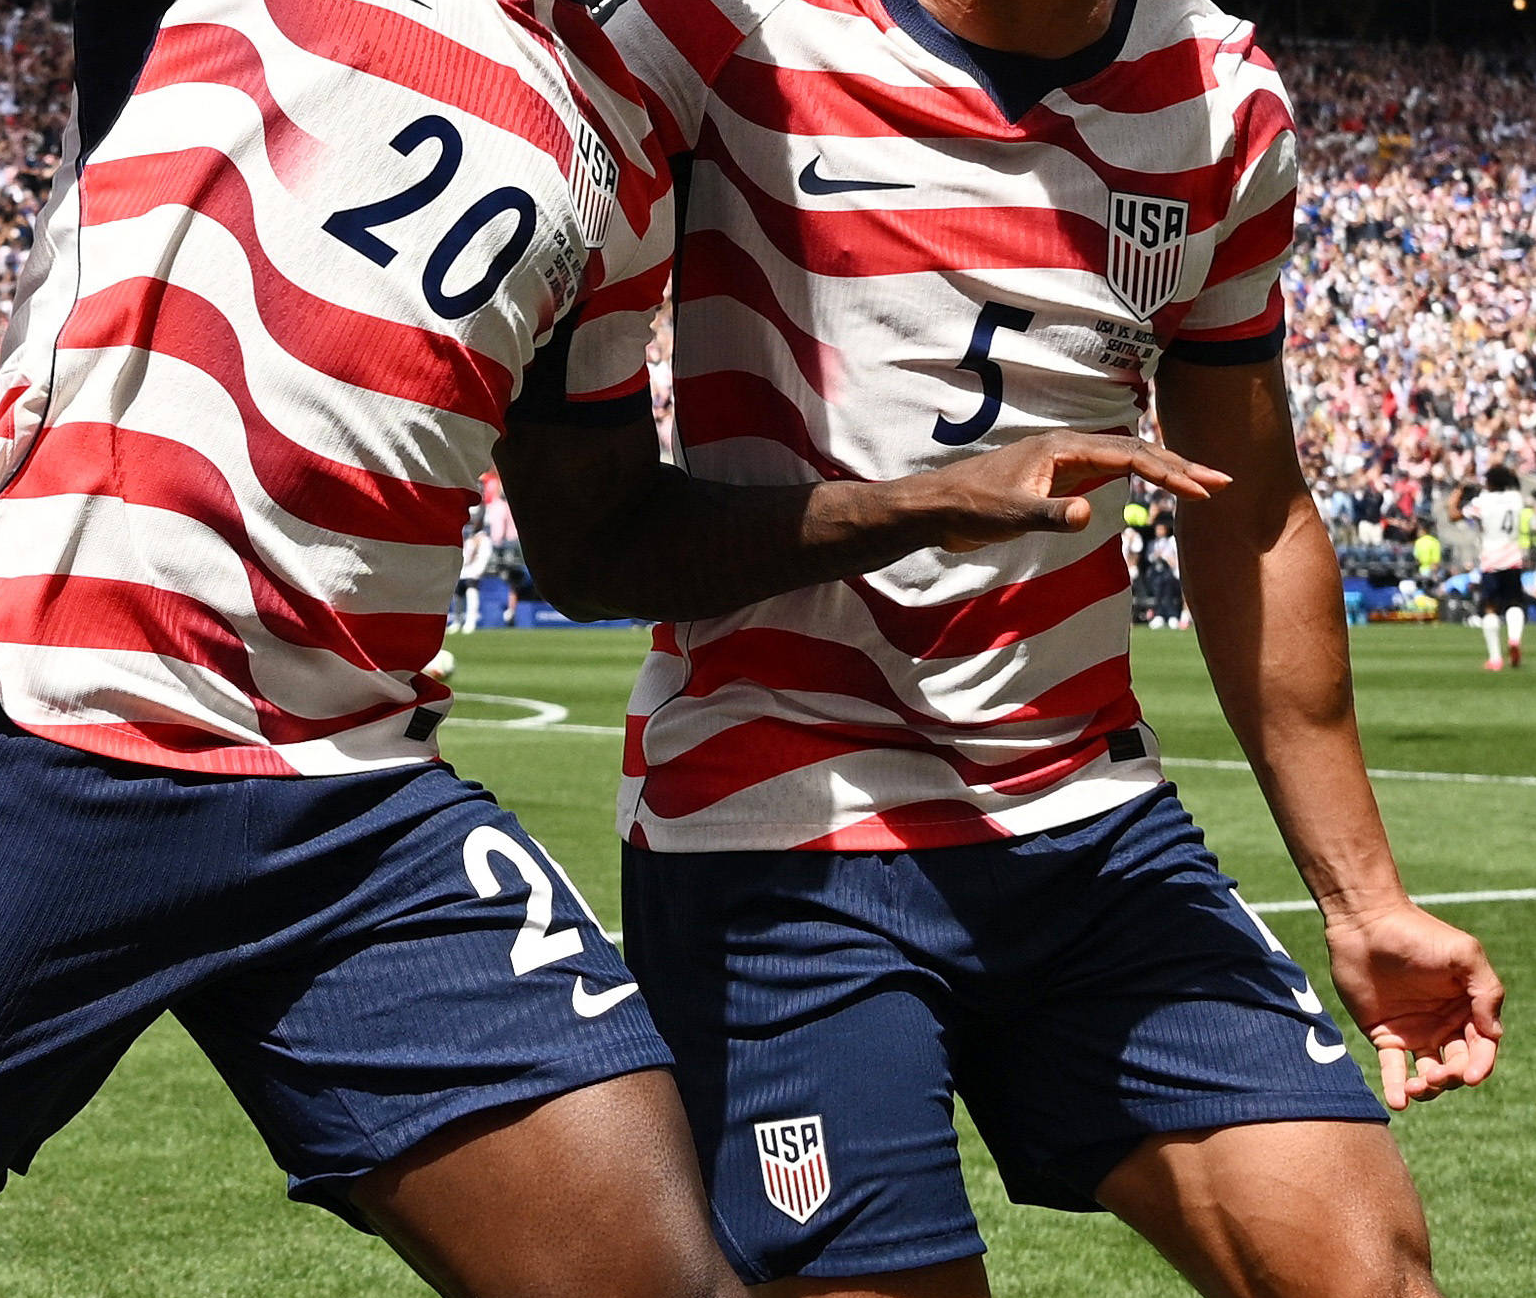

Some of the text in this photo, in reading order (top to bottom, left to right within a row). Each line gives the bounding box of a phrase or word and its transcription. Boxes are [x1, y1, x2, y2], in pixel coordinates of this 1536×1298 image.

[577, 122, 618, 194] USA
[321, 115, 537, 321] 20
[1115, 197, 1185, 250] USA
[931, 300, 1036, 447] 5
[462, 825, 614, 977] 2
[760, 1123, 818, 1164] USA
